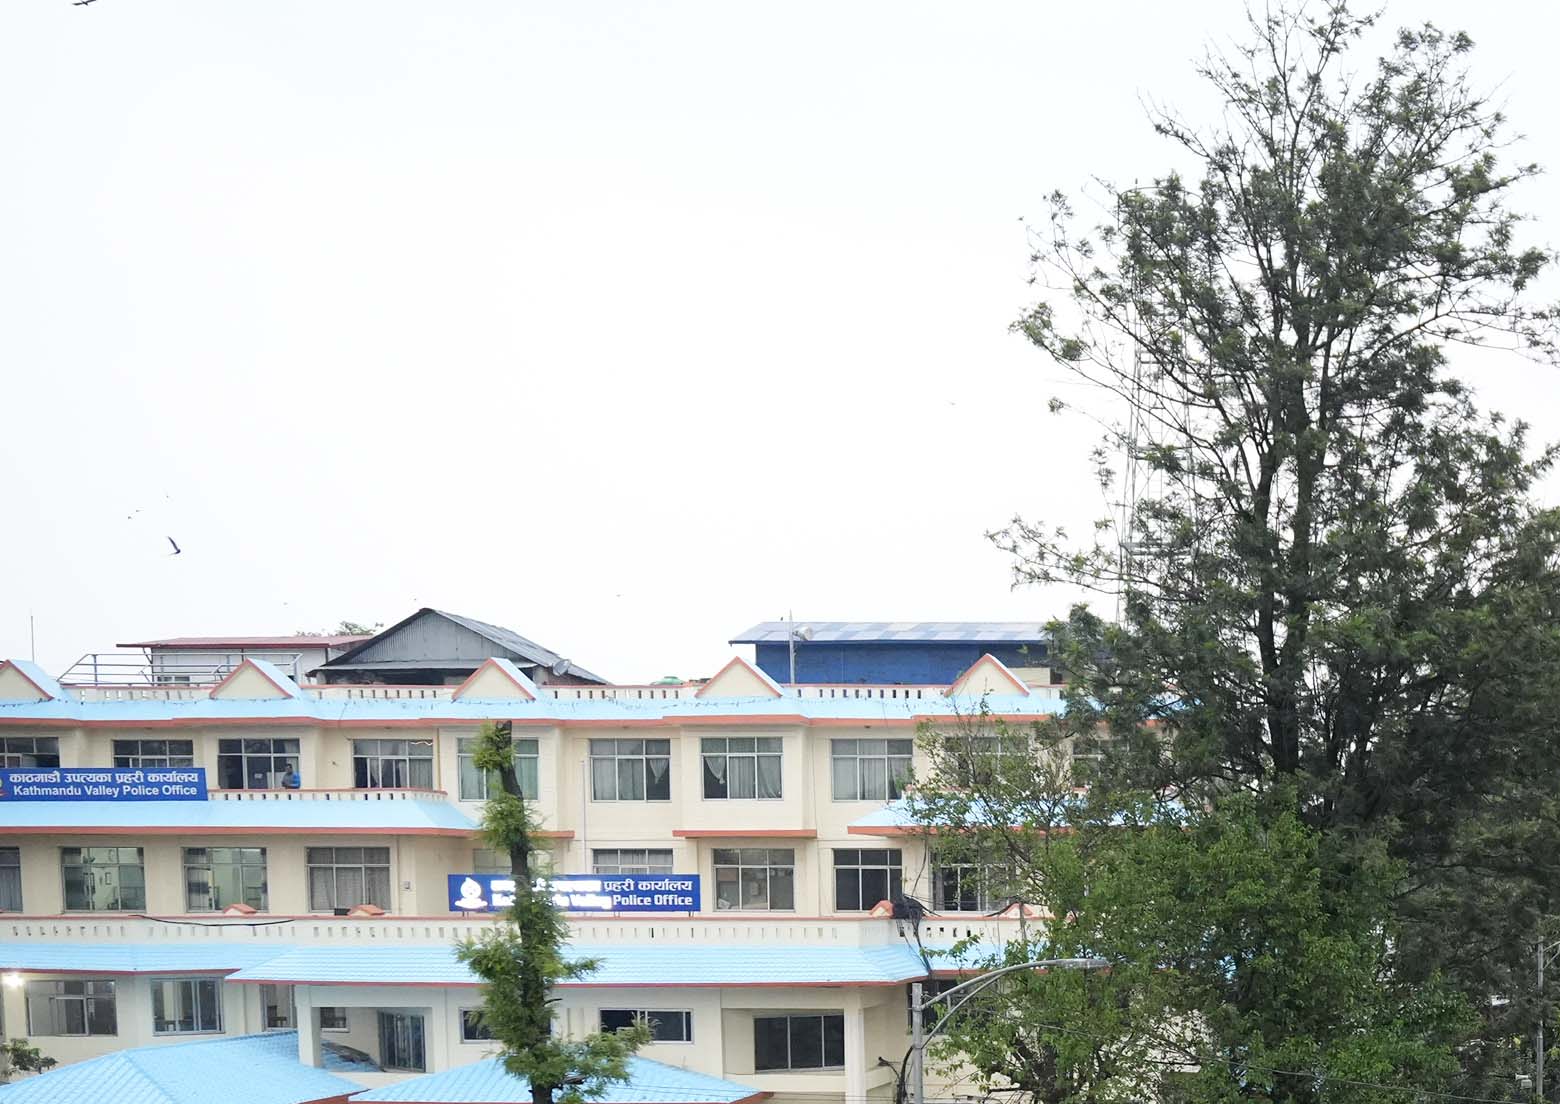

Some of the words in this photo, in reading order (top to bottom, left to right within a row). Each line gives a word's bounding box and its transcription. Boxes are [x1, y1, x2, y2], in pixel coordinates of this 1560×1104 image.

[64, 773, 112, 783] उपत्यका
[115, 771, 144, 784] प्रहरी
[148, 771, 199, 783] कार्यालय
[14, 785, 81, 796] Kathmandu
[85, 785, 119, 798] Valley
[123, 785, 159, 796] Police
[162, 785, 197, 795] Office
[603, 879, 635, 892] प्रहरी
[638, 879, 693, 892] कार्यालय
[613, 894, 652, 906] Police
[654, 894, 693, 906] Office
